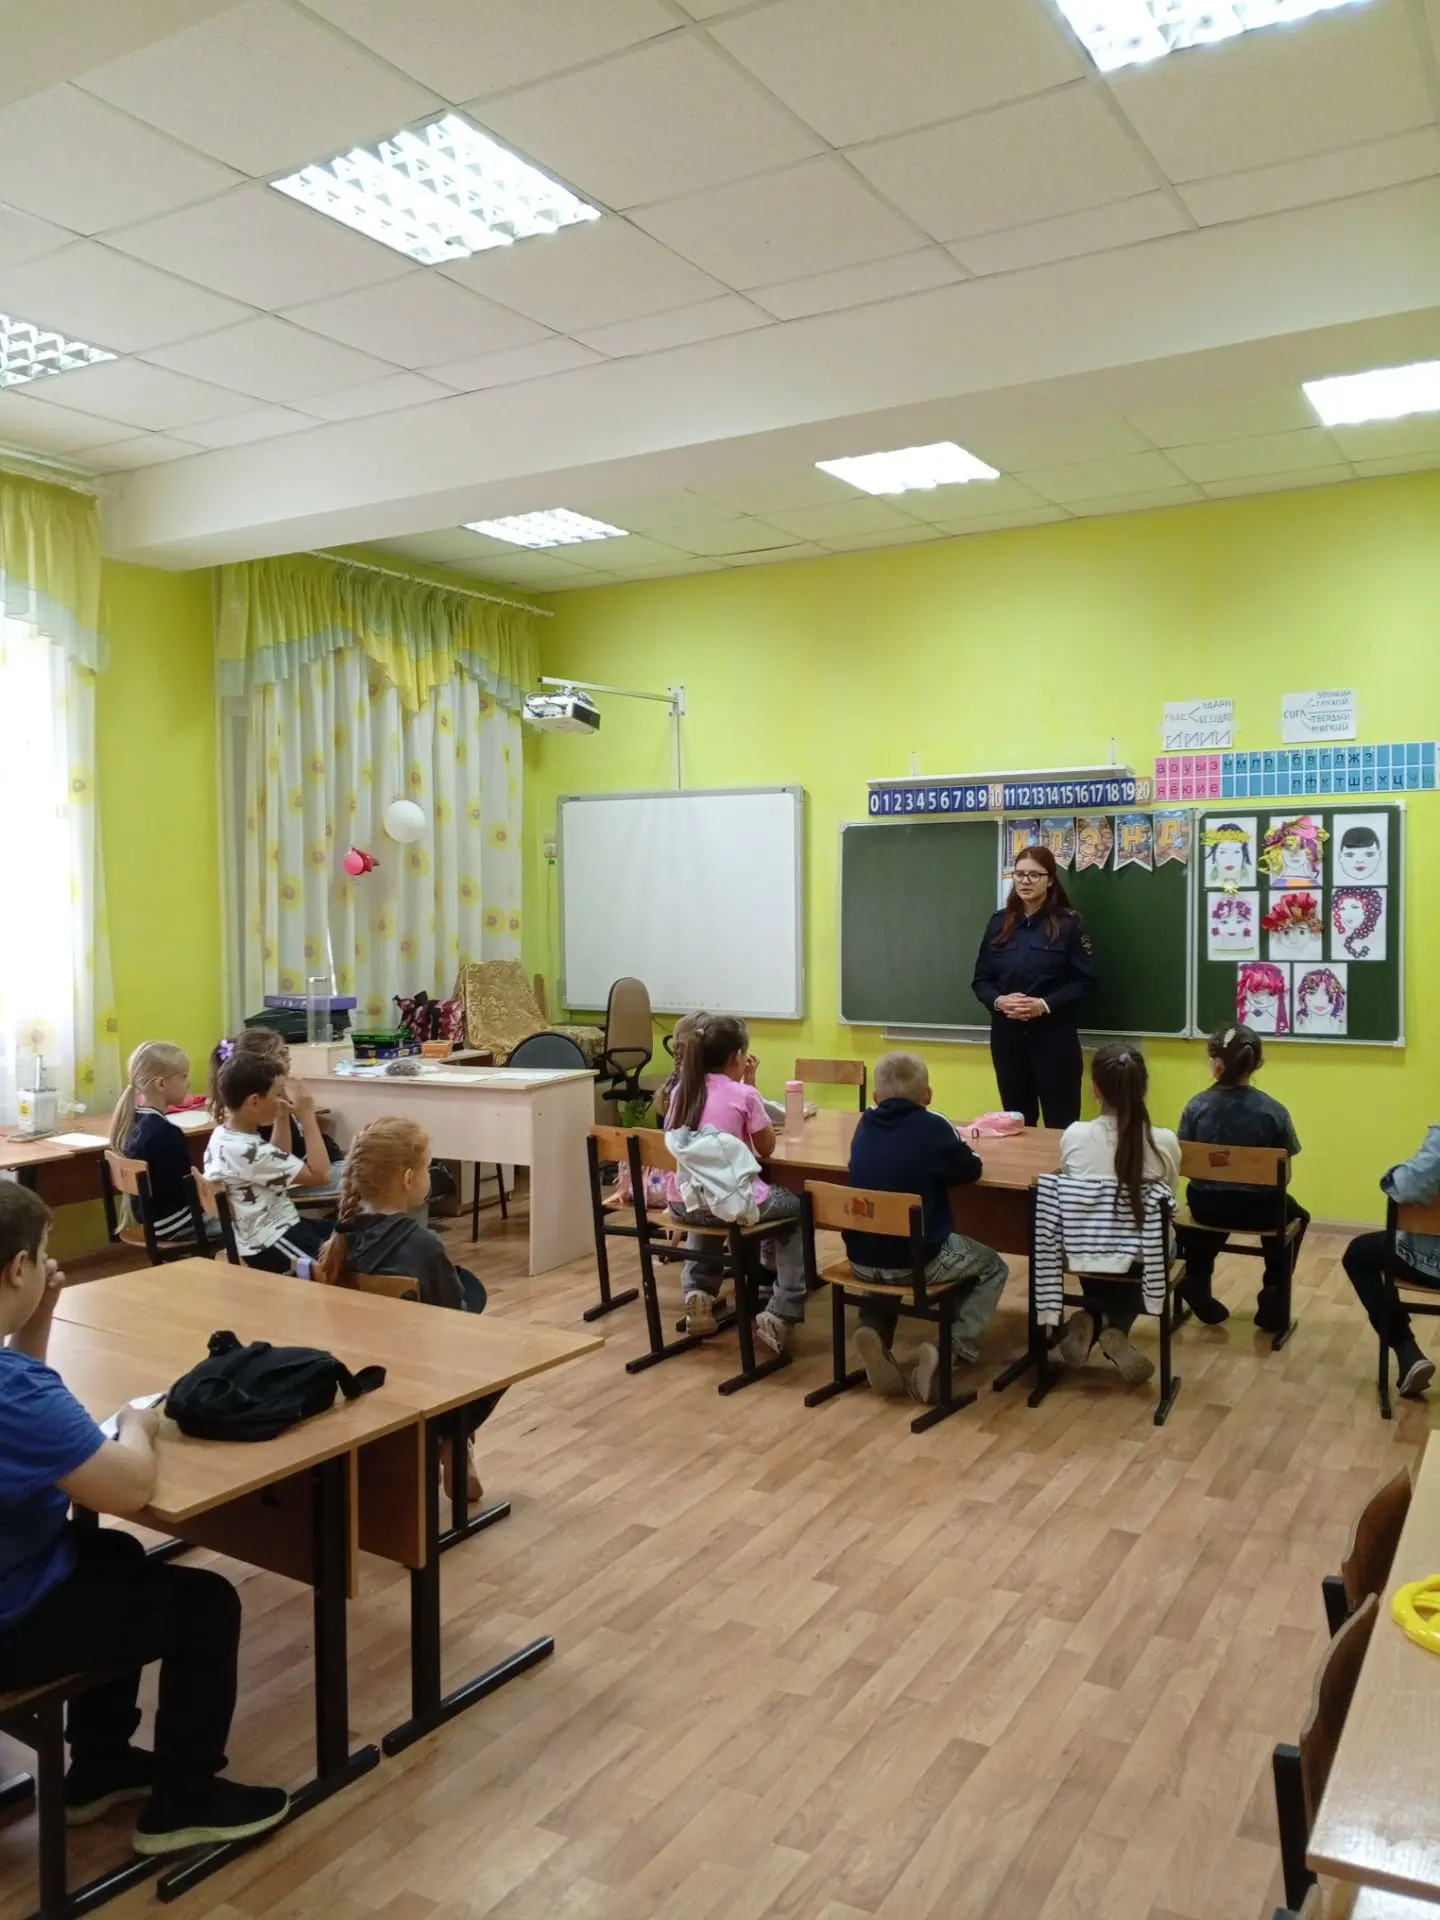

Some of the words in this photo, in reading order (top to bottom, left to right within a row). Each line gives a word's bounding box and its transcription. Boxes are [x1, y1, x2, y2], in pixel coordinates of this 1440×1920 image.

[1284, 709, 1306, 718] СОГЛ
[871, 795, 879, 812] 0
[883, 794, 889, 811] 1
[894, 794, 901, 810] 2
[906, 794, 913, 810] 3
[917, 793, 924, 809] 4
[928, 792, 936, 809] 5
[941, 791, 949, 809] 6
[953, 791, 961, 808] 7
[966, 790, 974, 808] 8
[978, 790, 987, 807] 9
[1004, 788, 1014, 806] 11
[1018, 788, 1029, 805] 12
[1032, 788, 1044, 805] 13
[1046, 787, 1059, 804] 14
[1061, 786, 1072, 804] 15
[1075, 785, 1088, 803] 16
[1090, 784, 1103, 802] 17
[1105, 783, 1119, 802] 18
[1121, 782, 1134, 801] 19
